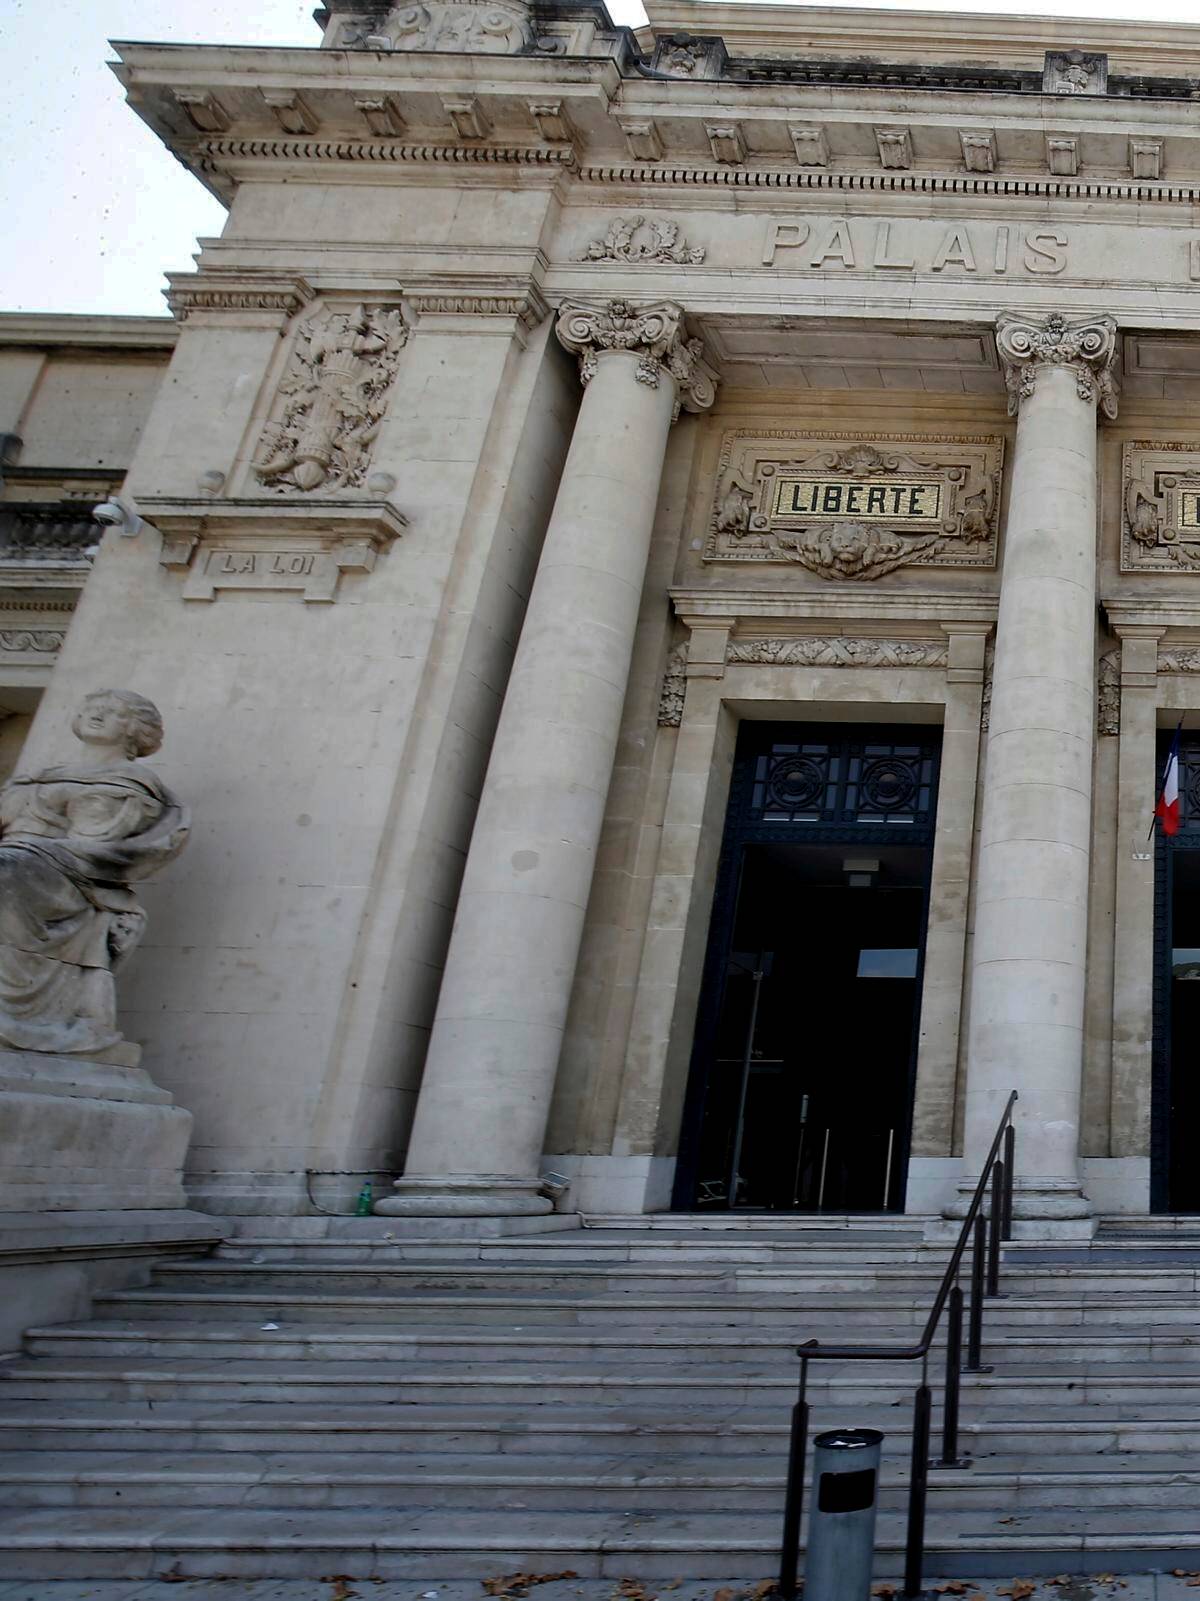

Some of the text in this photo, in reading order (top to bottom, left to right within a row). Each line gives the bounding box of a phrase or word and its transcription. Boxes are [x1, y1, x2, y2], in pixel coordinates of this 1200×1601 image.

[762, 219, 1068, 275] PALAIS
[791, 484, 926, 514] LIBERTÉ
[220, 554, 316, 575] LA LOI
